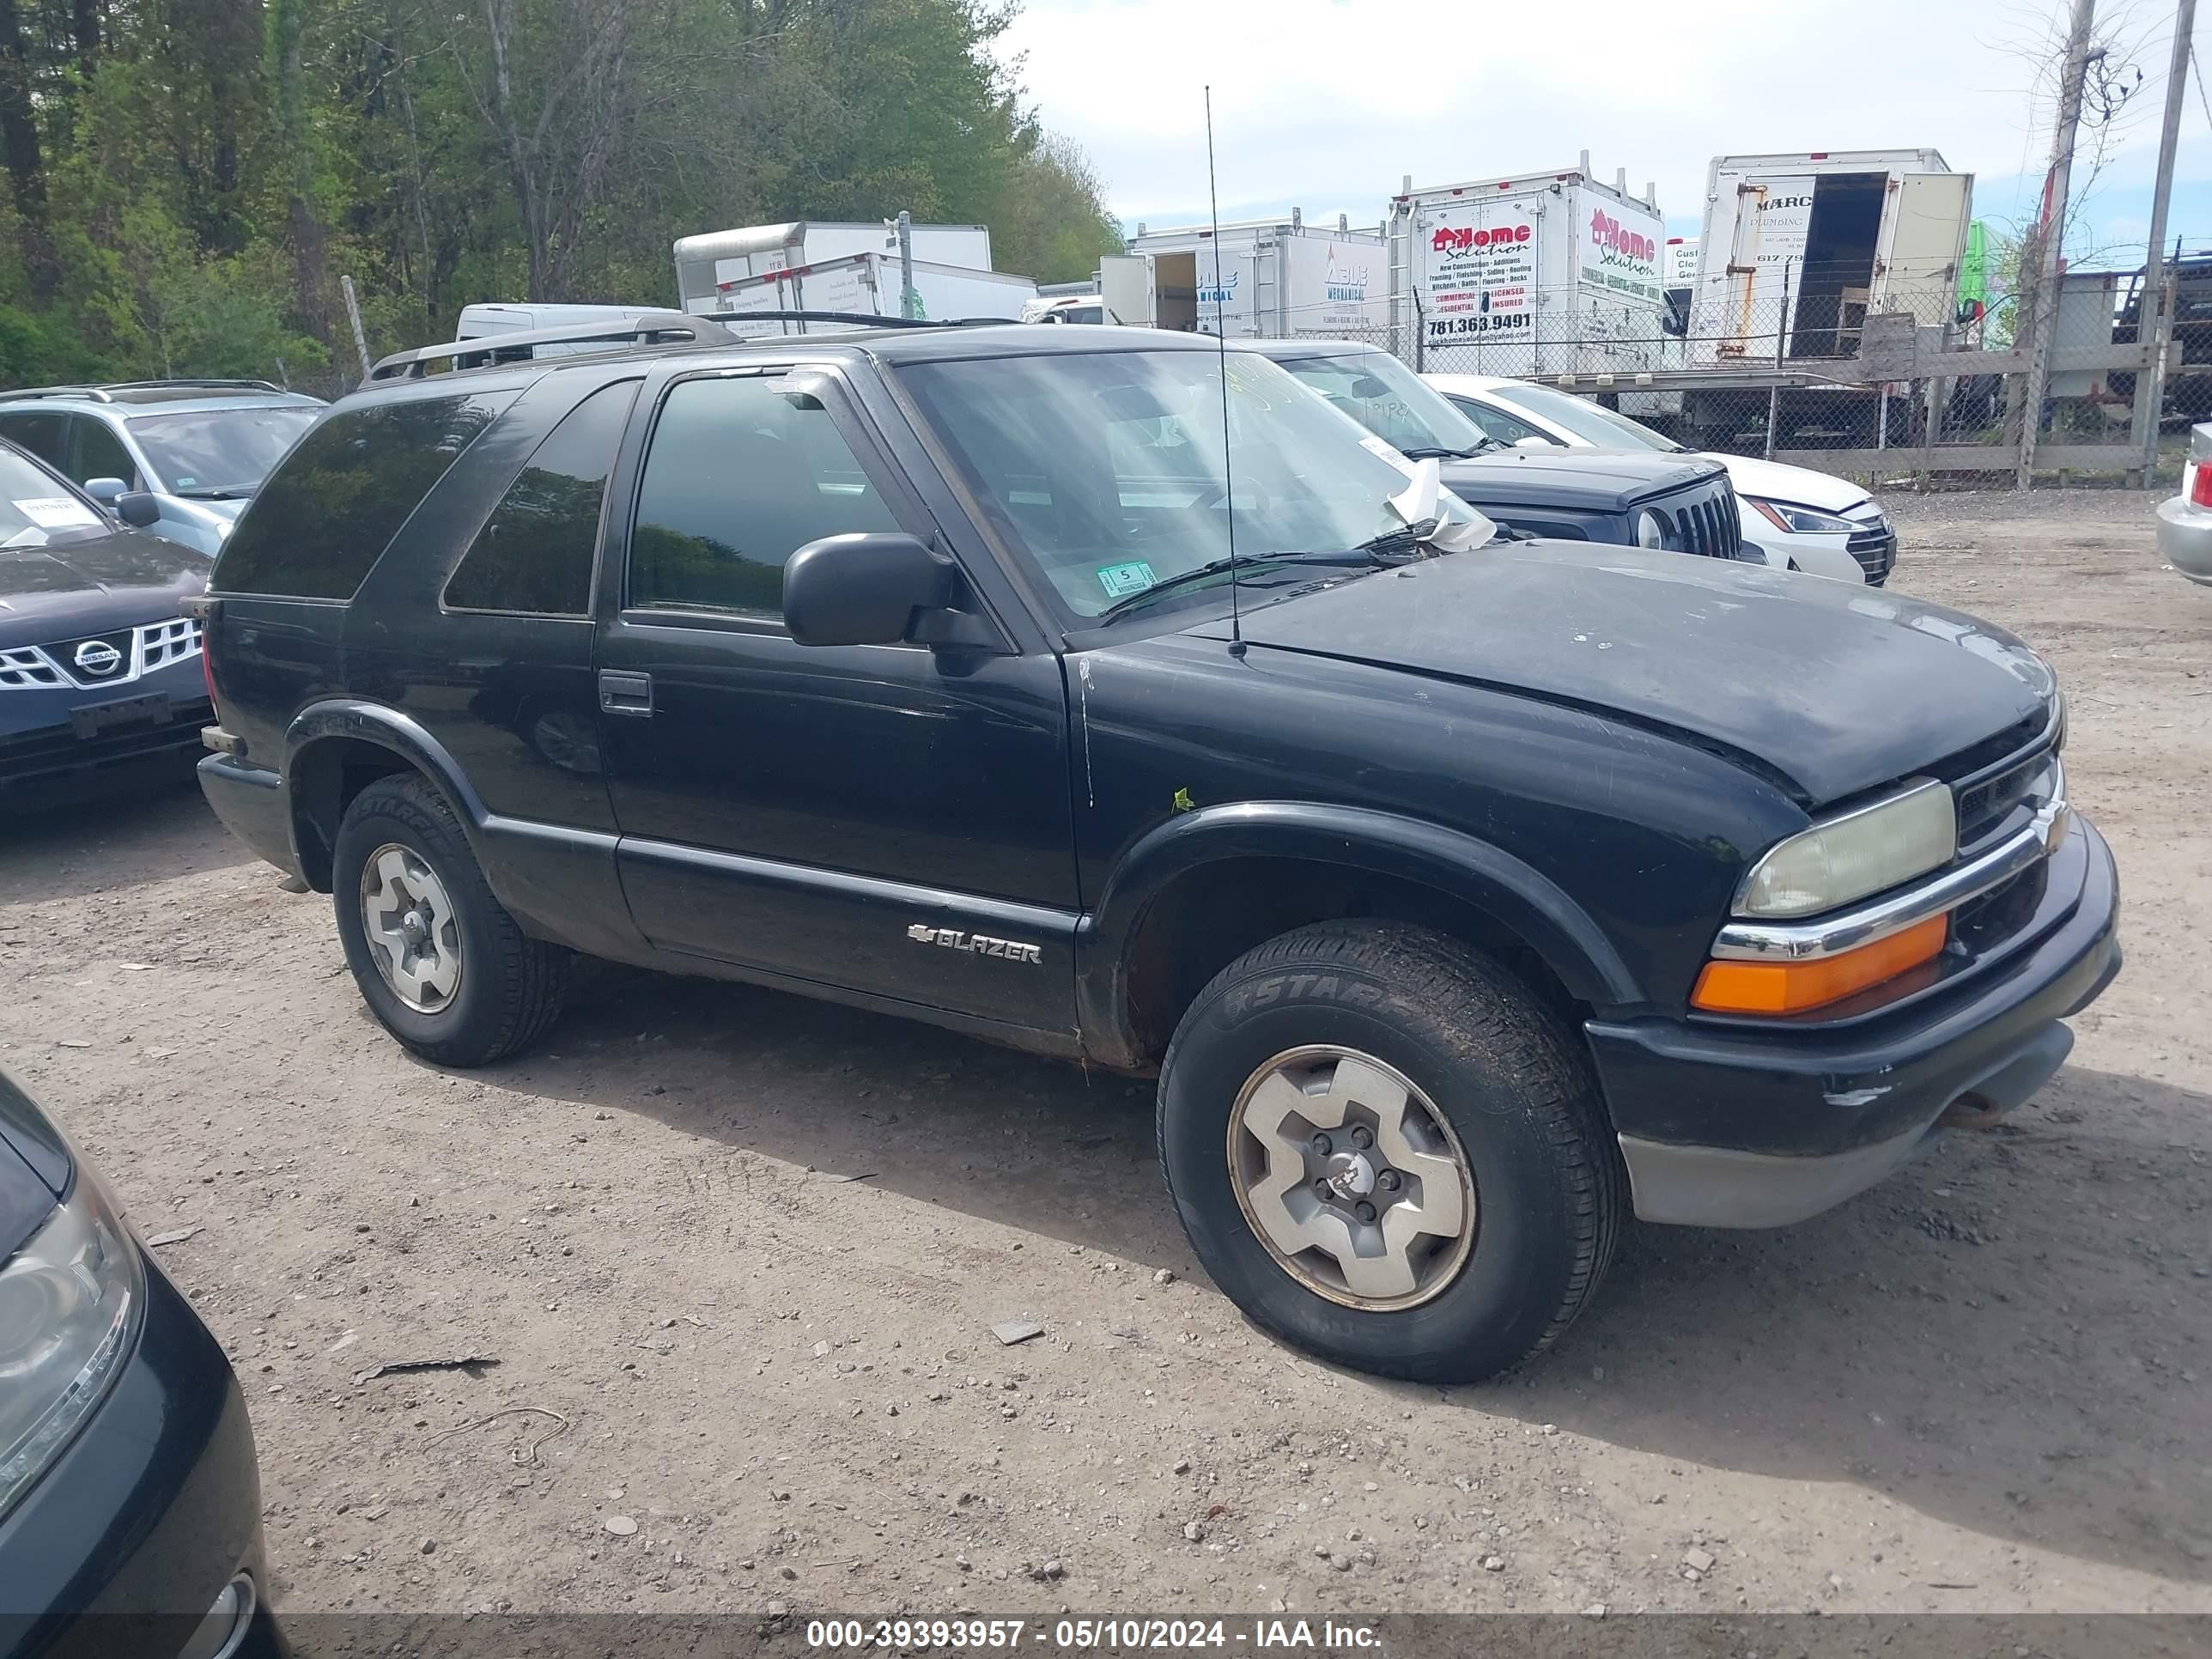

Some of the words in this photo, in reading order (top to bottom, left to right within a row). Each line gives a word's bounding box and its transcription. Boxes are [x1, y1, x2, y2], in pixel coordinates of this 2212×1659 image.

[1756, 196, 1813, 213] MARC
[1750, 218, 1803, 227] PLUMBING
[1454, 225, 1531, 249] Home
[1607, 216, 1656, 263] Home
[1445, 242, 1532, 262] Solution
[1600, 241, 1656, 276] Solution
[1493, 257, 1521, 266] Additions
[1429, 274, 1452, 283] Framing
[1456, 270, 1483, 279] Finishing
[1431, 282, 1457, 291] Kitchens
[1482, 276, 1505, 286] Flooring
[1197, 291, 1234, 302] NICAL
[1436, 292, 1475, 303] COMMERCIAL
[1491, 287, 1525, 298] LICENSED
[1492, 298, 1523, 309] INSURED
[1428, 313, 1530, 336] 781.363.9491
[1121, 569, 1131, 580] 5
[81, 652, 118, 663] NISSAN
[935, 928, 1043, 965] BLAZER
